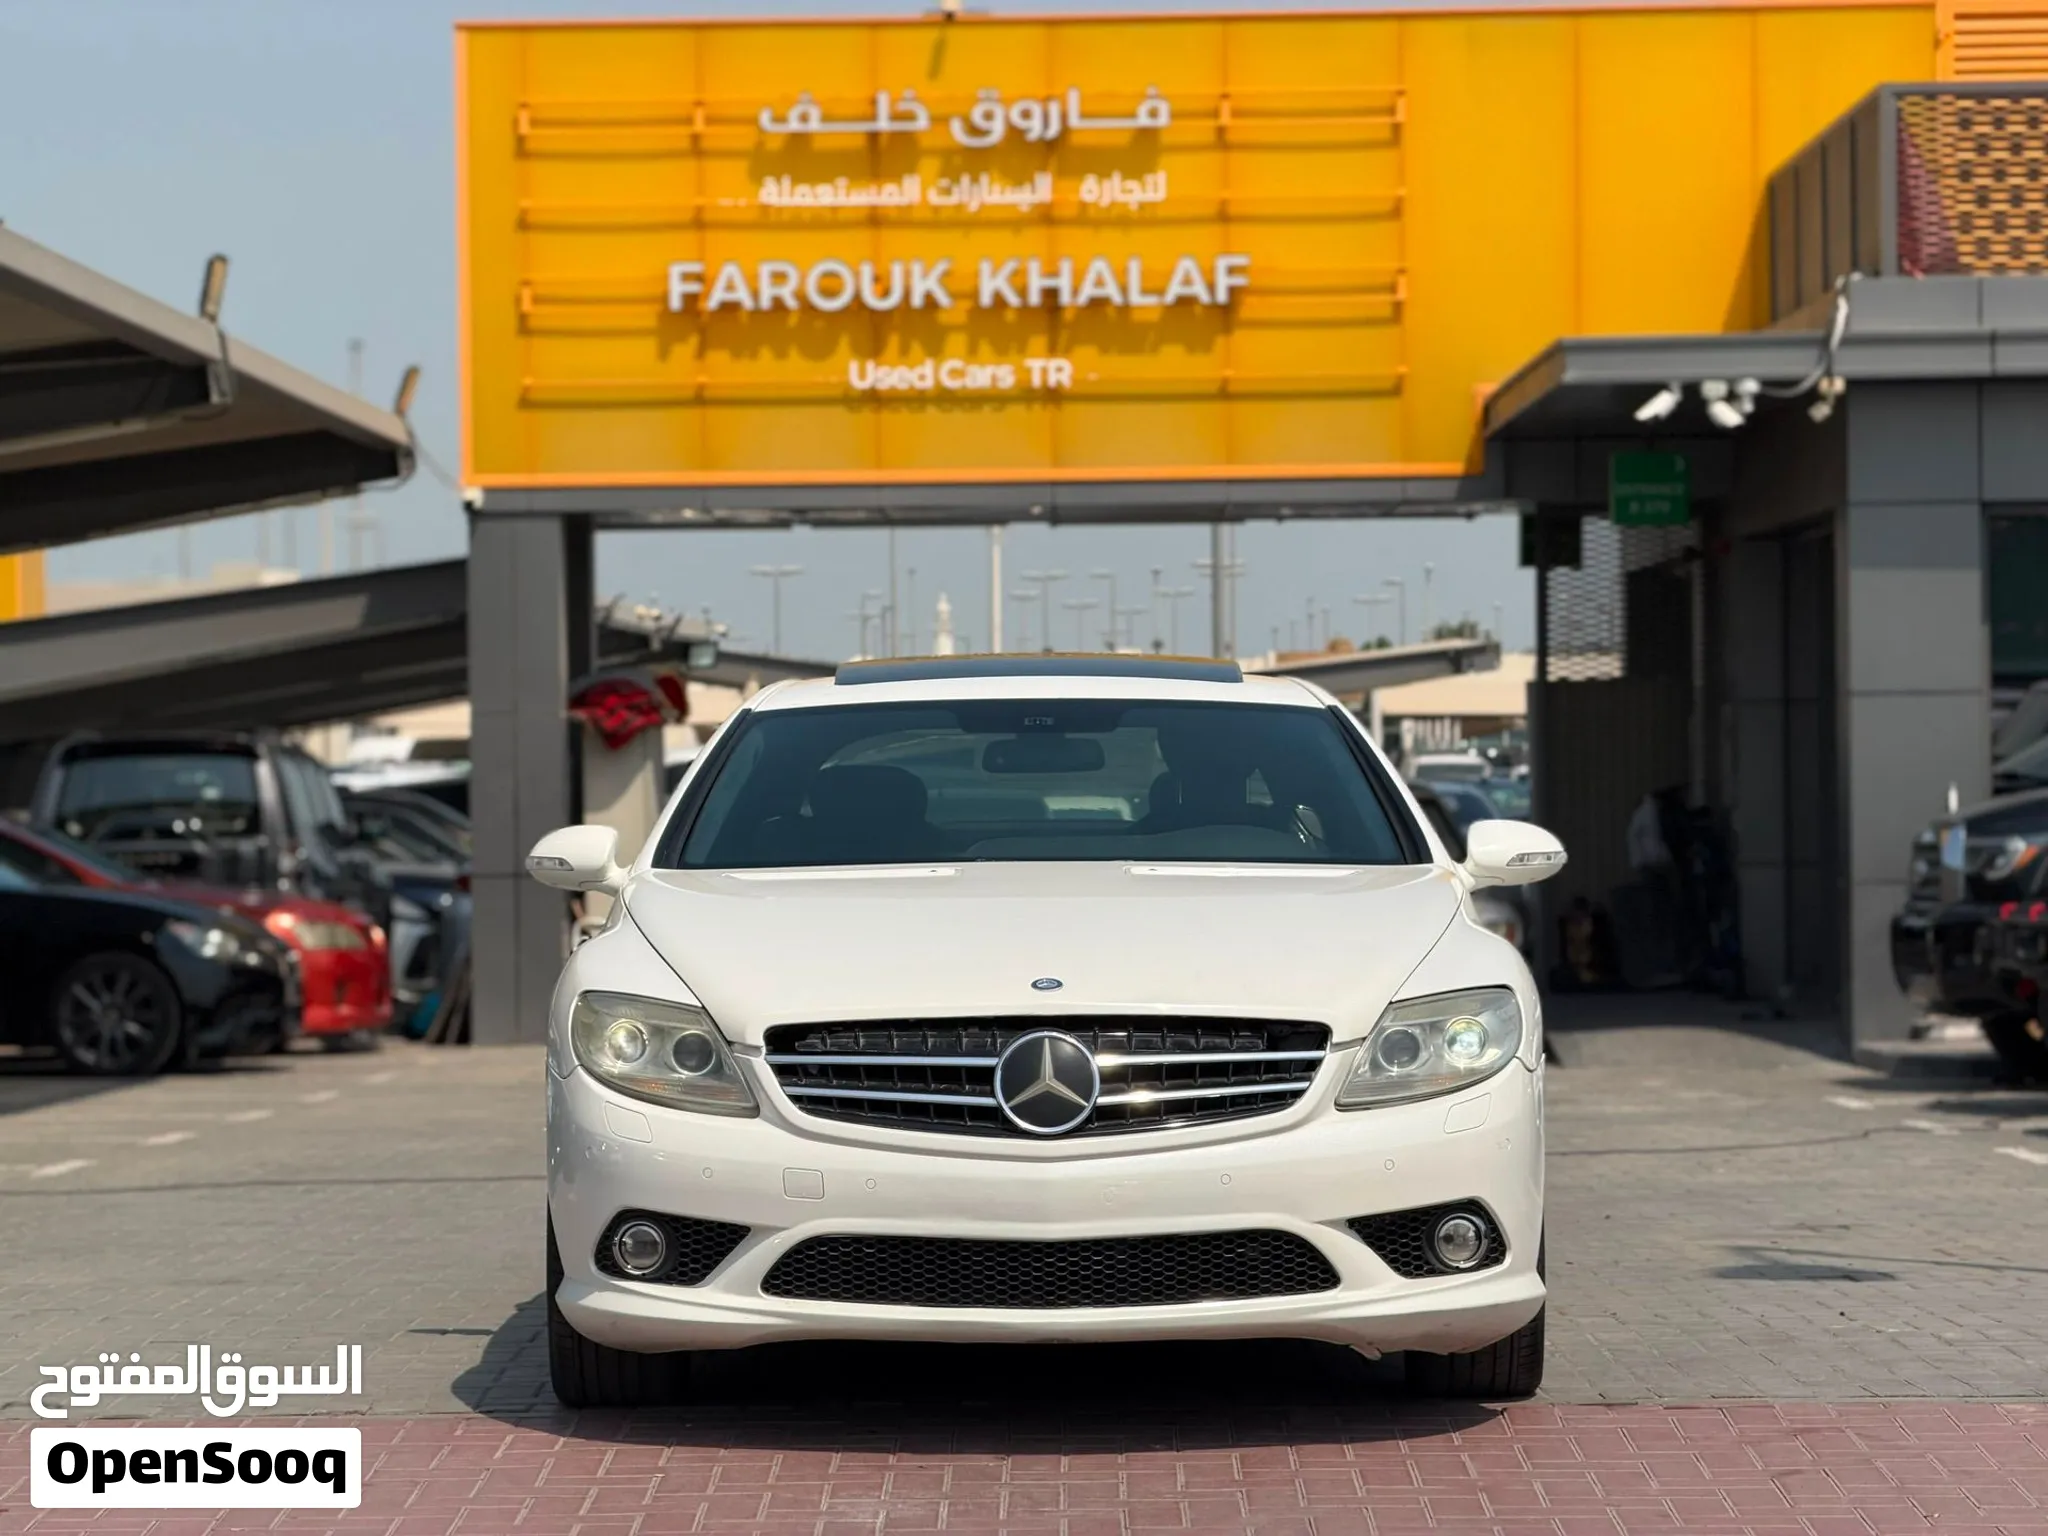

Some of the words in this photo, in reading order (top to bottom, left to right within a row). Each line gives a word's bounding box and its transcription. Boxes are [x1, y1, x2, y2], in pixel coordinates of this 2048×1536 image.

[758, 174, 922, 206] المستعملة
[926, 171, 1052, 212] السيارات
[666, 257, 953, 312] FAROUK
[978, 254, 1251, 309] KHALAF
[849, 357, 935, 390] Used
[939, 358, 1016, 389] Cars
[1024, 357, 1073, 389] TR
